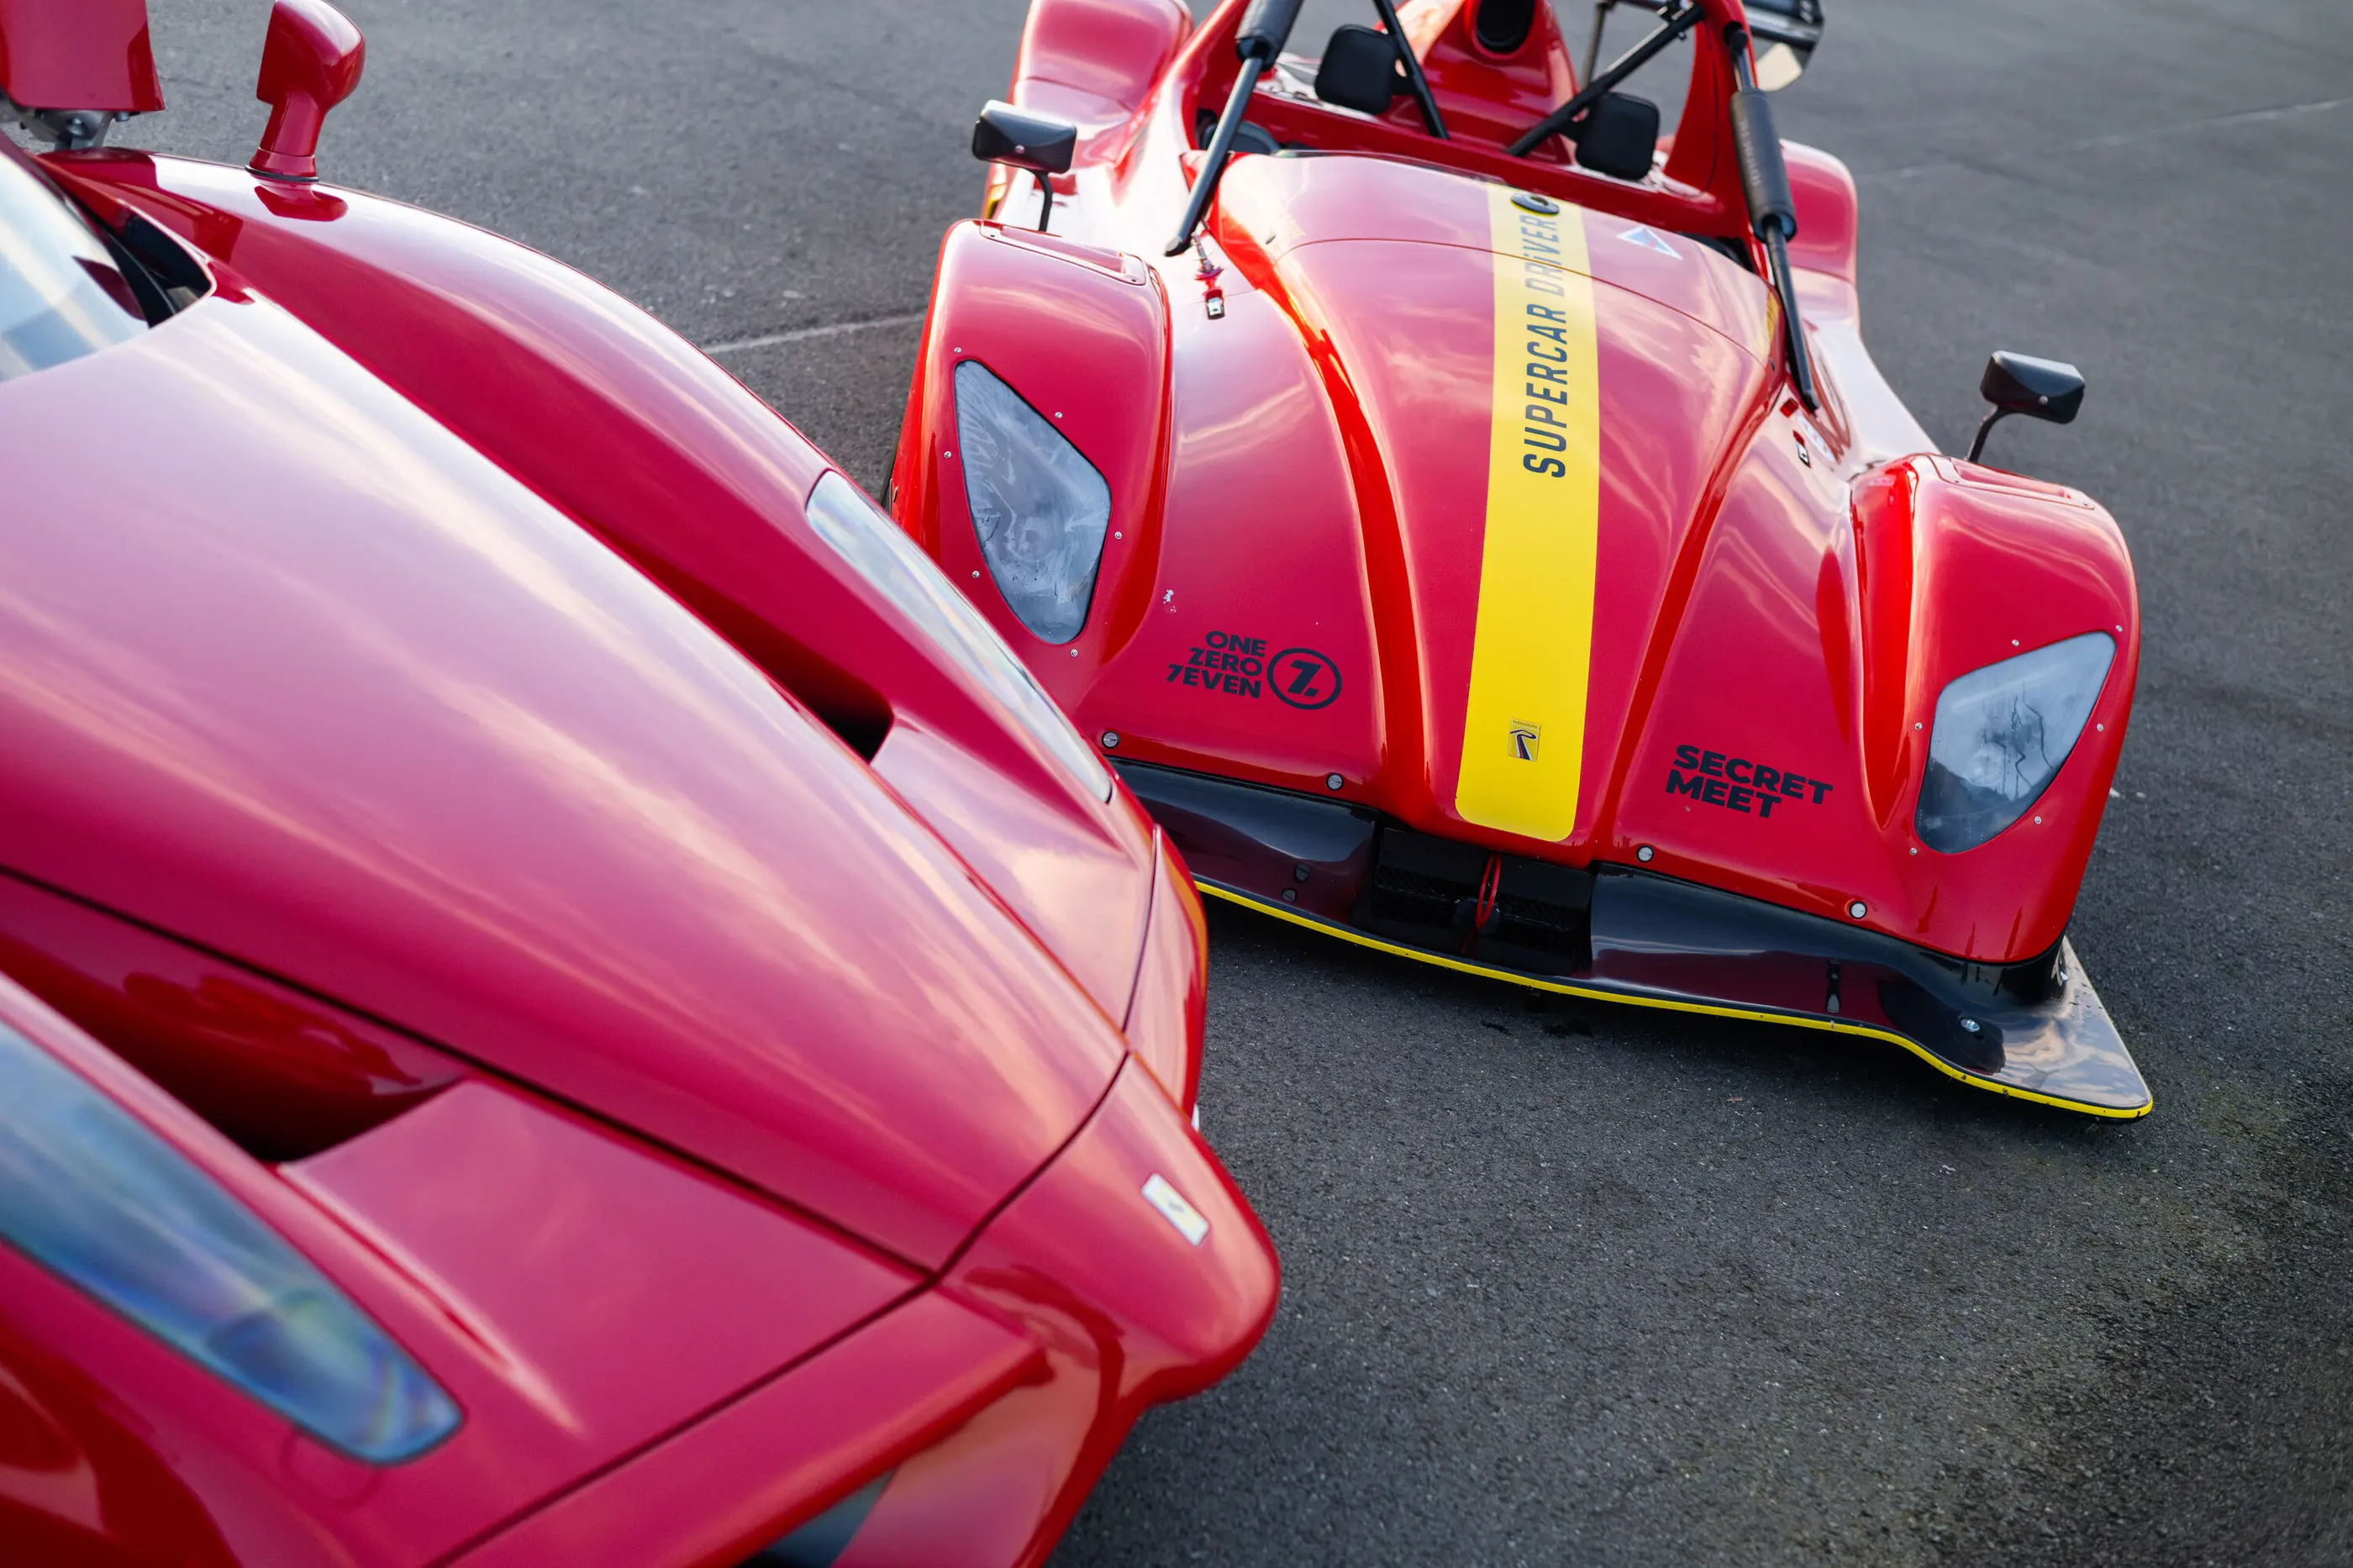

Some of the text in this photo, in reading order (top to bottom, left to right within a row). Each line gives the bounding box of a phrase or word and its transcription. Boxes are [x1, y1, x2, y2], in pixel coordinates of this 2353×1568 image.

[1523, 303, 1568, 478] SUPERCAR
[1187, 647, 1262, 676] ZERO
[1205, 630, 1267, 657] ONE
[1166, 664, 1262, 699] 7EVEN
[1665, 769, 1782, 818] MEET
[1673, 745, 1834, 805] SECRET
